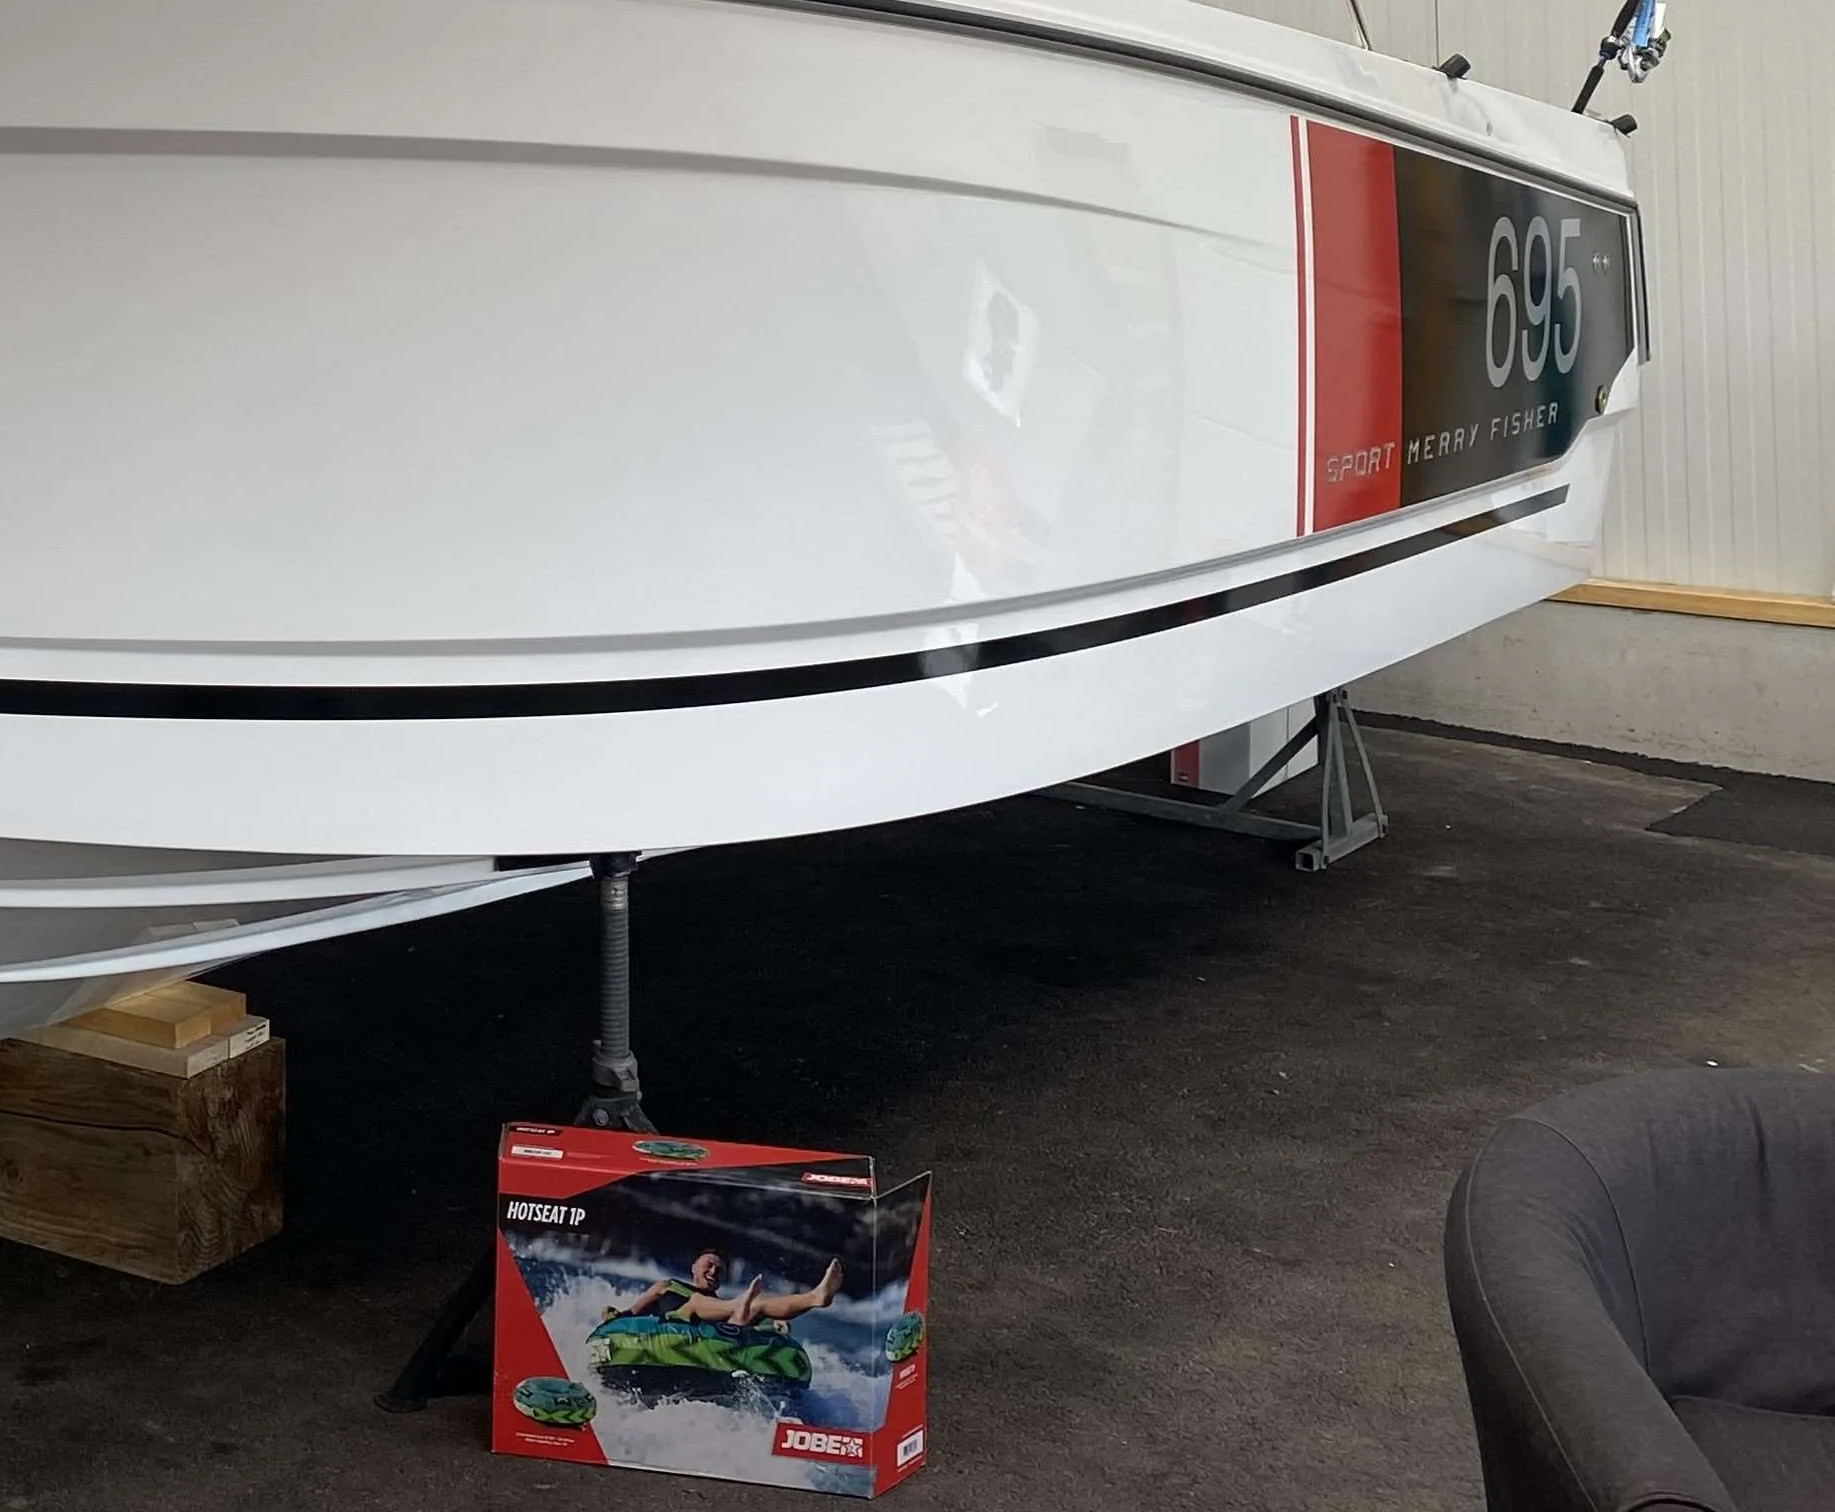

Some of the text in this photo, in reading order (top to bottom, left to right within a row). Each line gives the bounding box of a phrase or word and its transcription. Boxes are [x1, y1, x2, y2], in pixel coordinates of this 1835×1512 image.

[1485, 216, 1581, 388] 695
[1327, 402, 1558, 483] SPORT MERRY FISHER
[506, 1201, 586, 1227] HOTSEAT 1P
